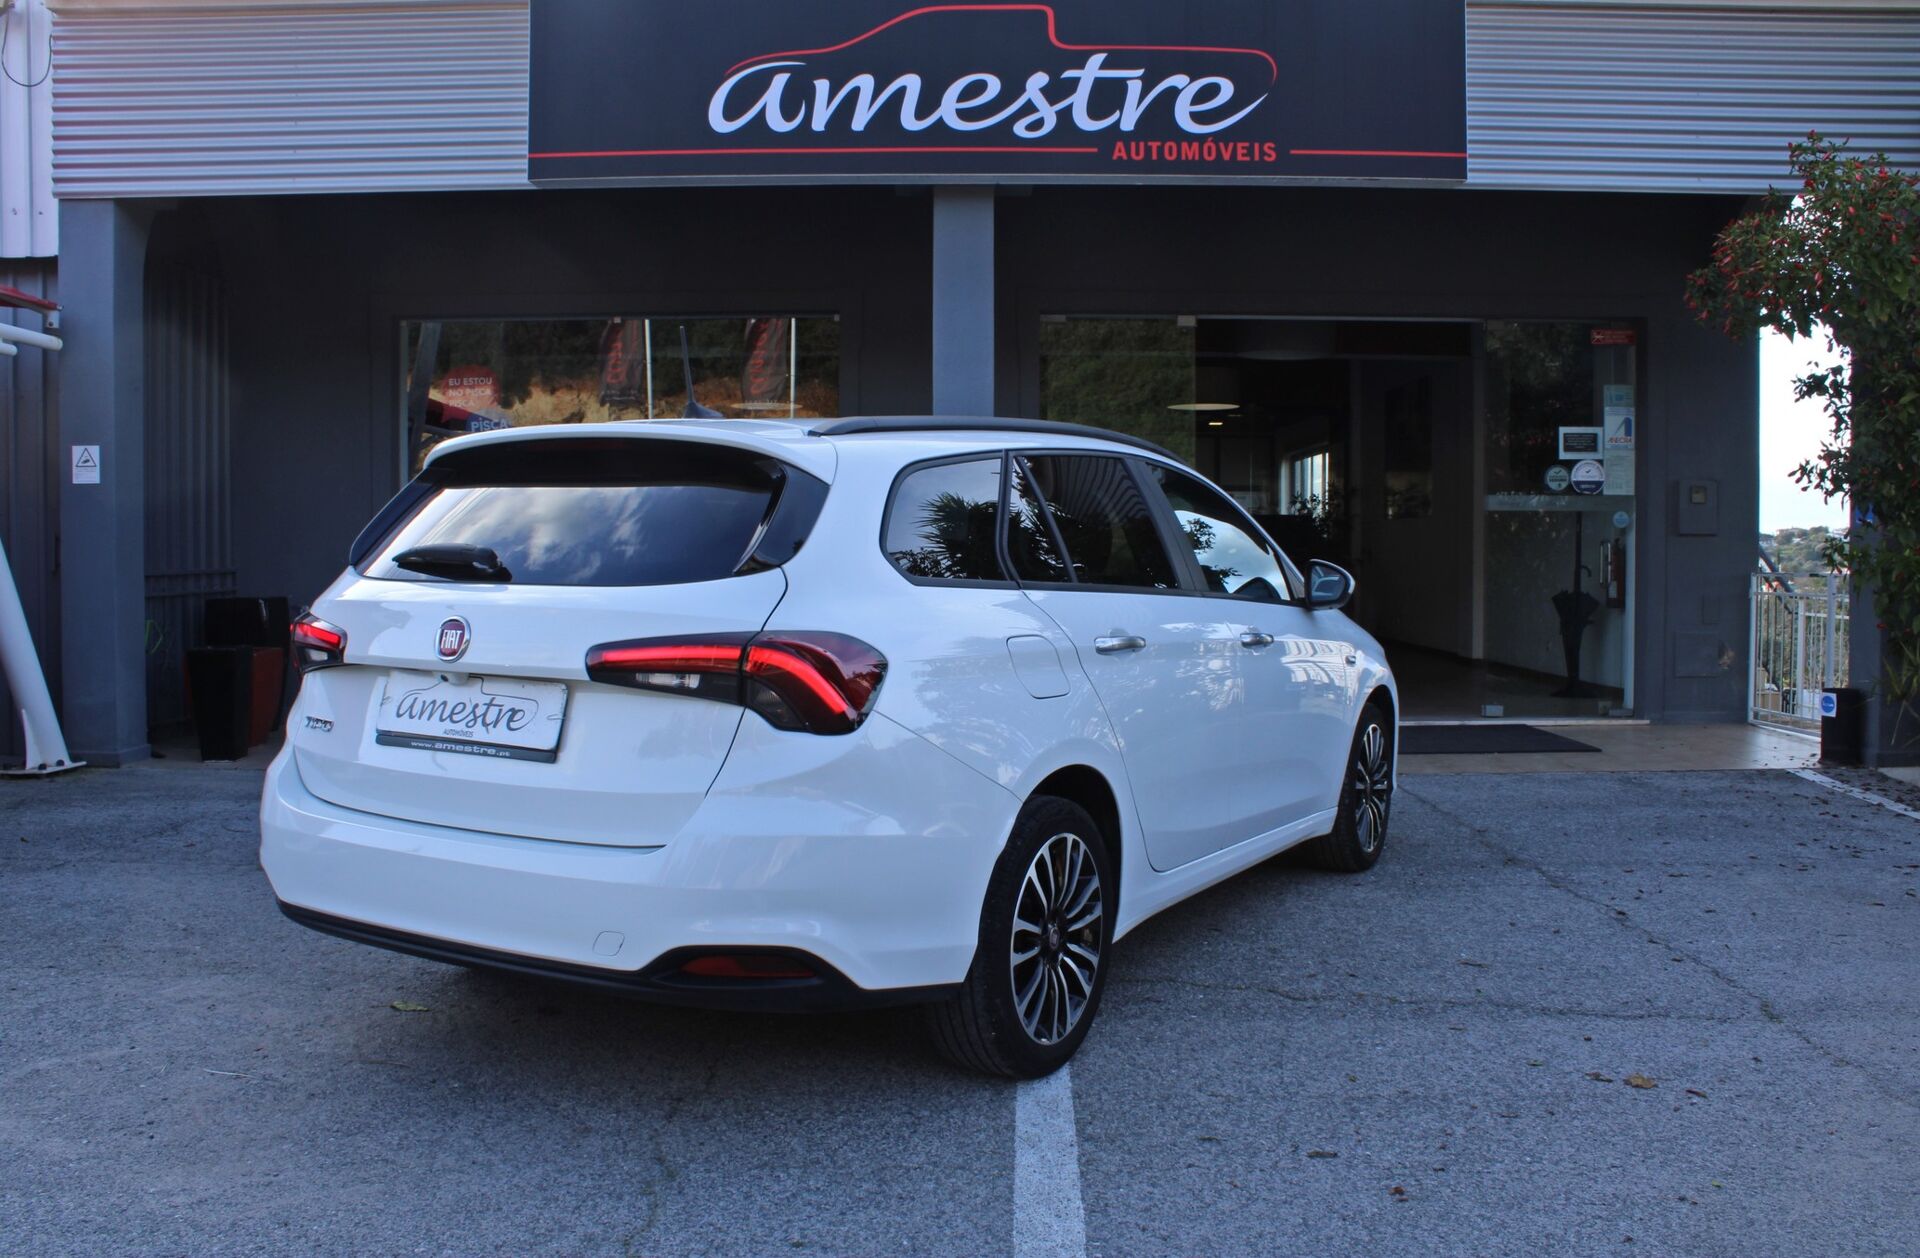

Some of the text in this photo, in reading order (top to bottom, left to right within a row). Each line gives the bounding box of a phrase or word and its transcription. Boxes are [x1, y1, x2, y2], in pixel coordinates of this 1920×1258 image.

[708, 52, 1268, 139] amestre
[1112, 137, 1277, 162] AUTOMÓVEIS
[448, 377, 493, 386] EU ESTOU
[440, 629, 464, 650] FIAT
[396, 692, 530, 732] amestre
[410, 740, 511, 758] www.amestre.pt
